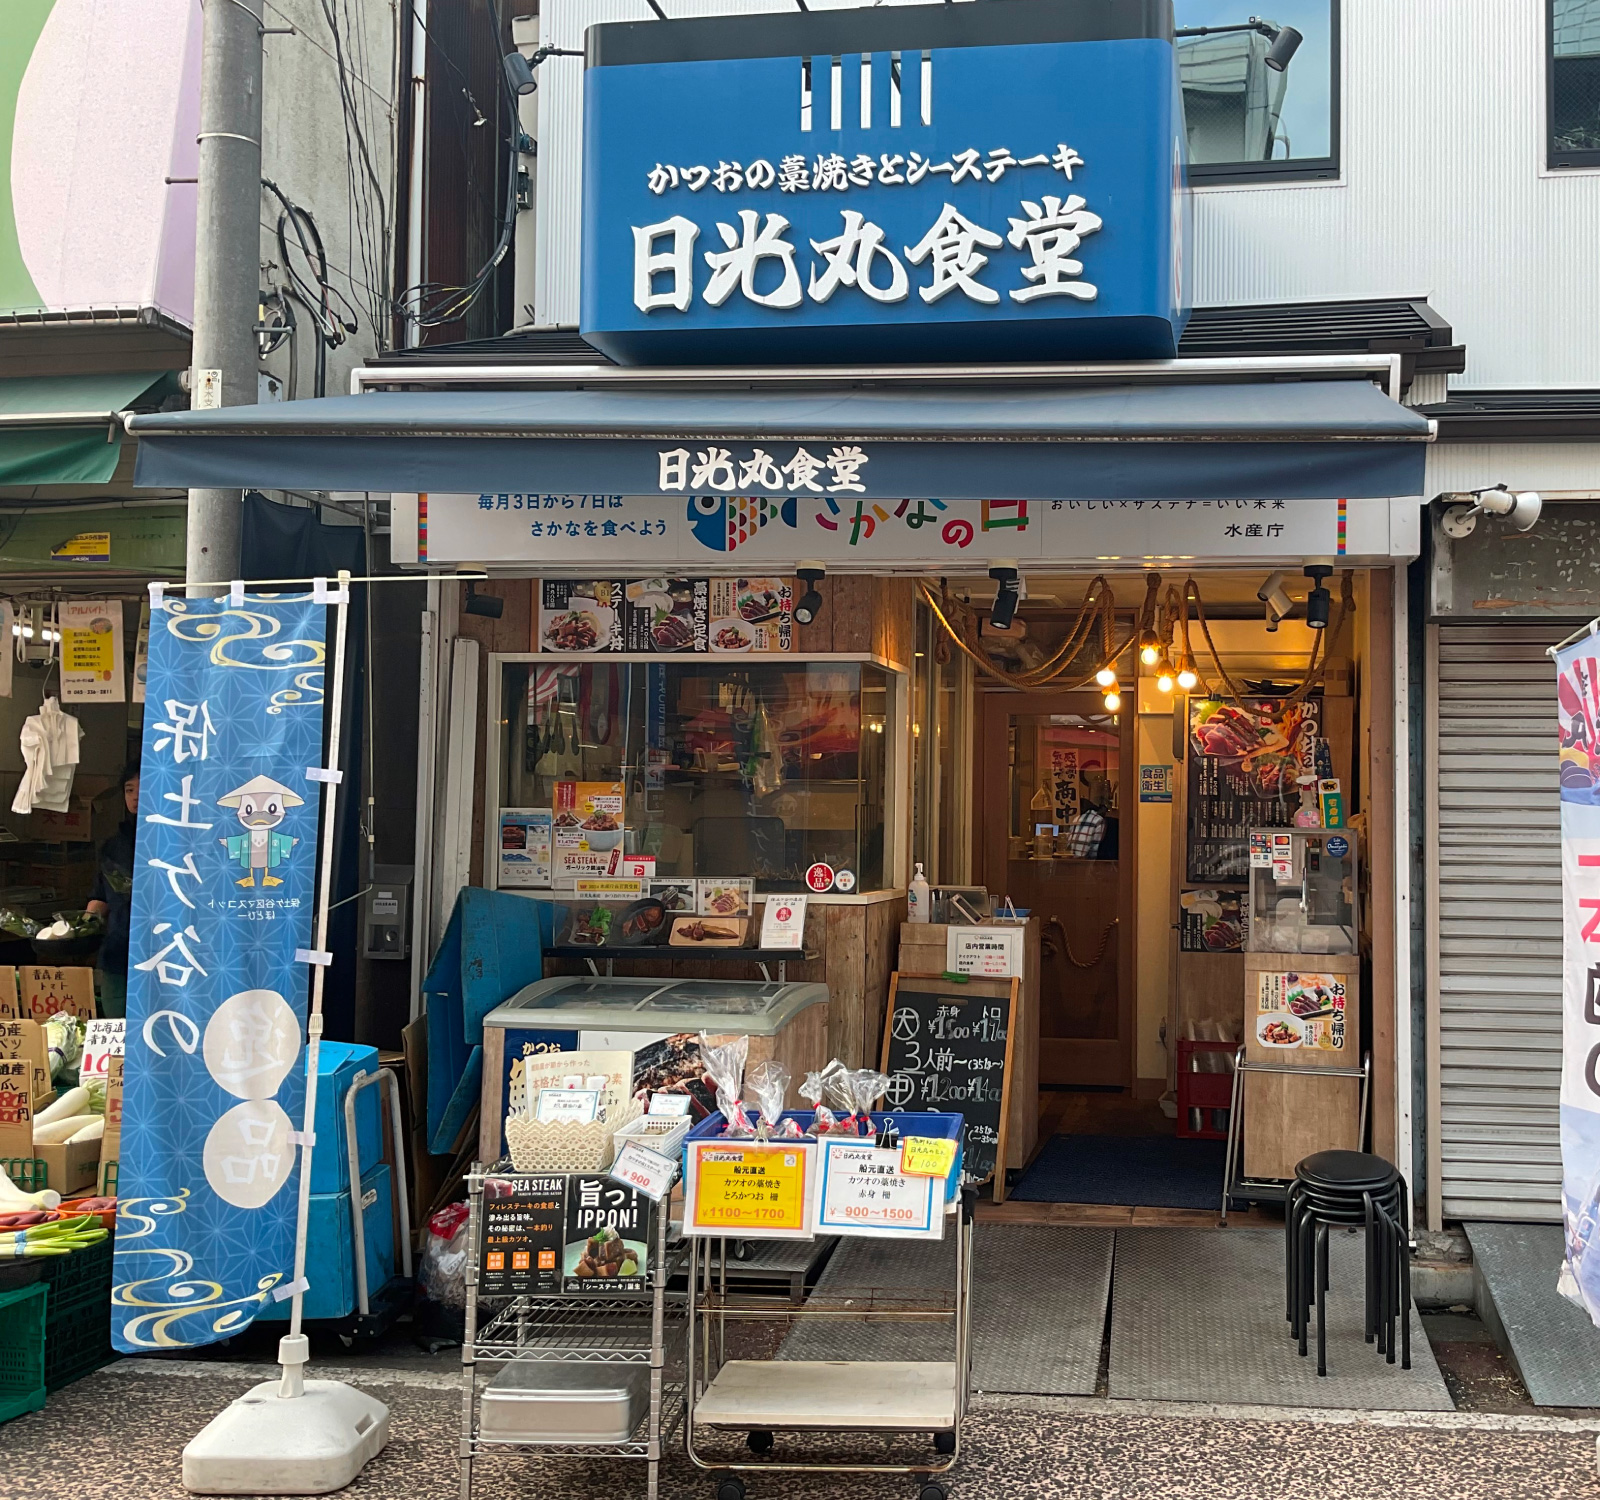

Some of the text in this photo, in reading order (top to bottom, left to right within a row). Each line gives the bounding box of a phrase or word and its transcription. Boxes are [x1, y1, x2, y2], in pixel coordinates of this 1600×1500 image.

[647, 143, 1085, 194] かつおの藁焼きとシーステーキ
[629, 195, 1103, 314] 日光丸食堂
[657, 446, 869, 493] 日光丸食堂
[477, 494, 623, 510] 毎月3日から7日は
[531, 519, 666, 537] さかなを食べよう
[1224, 523, 1285, 538] 水産庁
[609, 582, 624, 651] ステーキ丼
[693, 581, 709, 652] 藁焼き定食
[778, 585, 793, 651] お持ち帰り
[1141, 768, 1164, 779] 食品
[1141, 780, 1164, 792] 衛生
[563, 856, 598, 865] SEA STEAK
[813, 866, 825, 889] 逸品
[965, 942, 1005, 951] 店内営業時間
[32, 969, 66, 981] 青森産
[40, 983, 69, 991] トマト
[31, 994, 77, 1016] 680
[936, 1004, 1001, 1019] 赤身 トロ
[1330, 983, 1346, 1050] お持ち帰り
[733, 1165, 766, 1175] 船元直送
[858, 1164, 895, 1175] 船元直送
[920, 1159, 938, 1169] 100
[512, 1179, 563, 1191] SEA STEAK
[630, 1171, 651, 1187] 900
[723, 1178, 781, 1189] カツオの藁焼き
[848, 1176, 906, 1188] カツオの藁焼き
[723, 1191, 779, 1202] とろかつお 柵
[858, 1189, 891, 1200] 赤身 柵
[489, 1201, 561, 1211] フィレステーキの食感と
[577, 1209, 638, 1229] IPPON!
[709, 1206, 785, 1220] 1100〜1700
[829, 1206, 913, 1220] ¥ 900〜1500
[487, 1224, 554, 1233] その秘密は、一本釣り
[487, 1235, 533, 1245] 最上級カツオ。
[581, 1282, 641, 1291] 「シーステーキ」誕生
